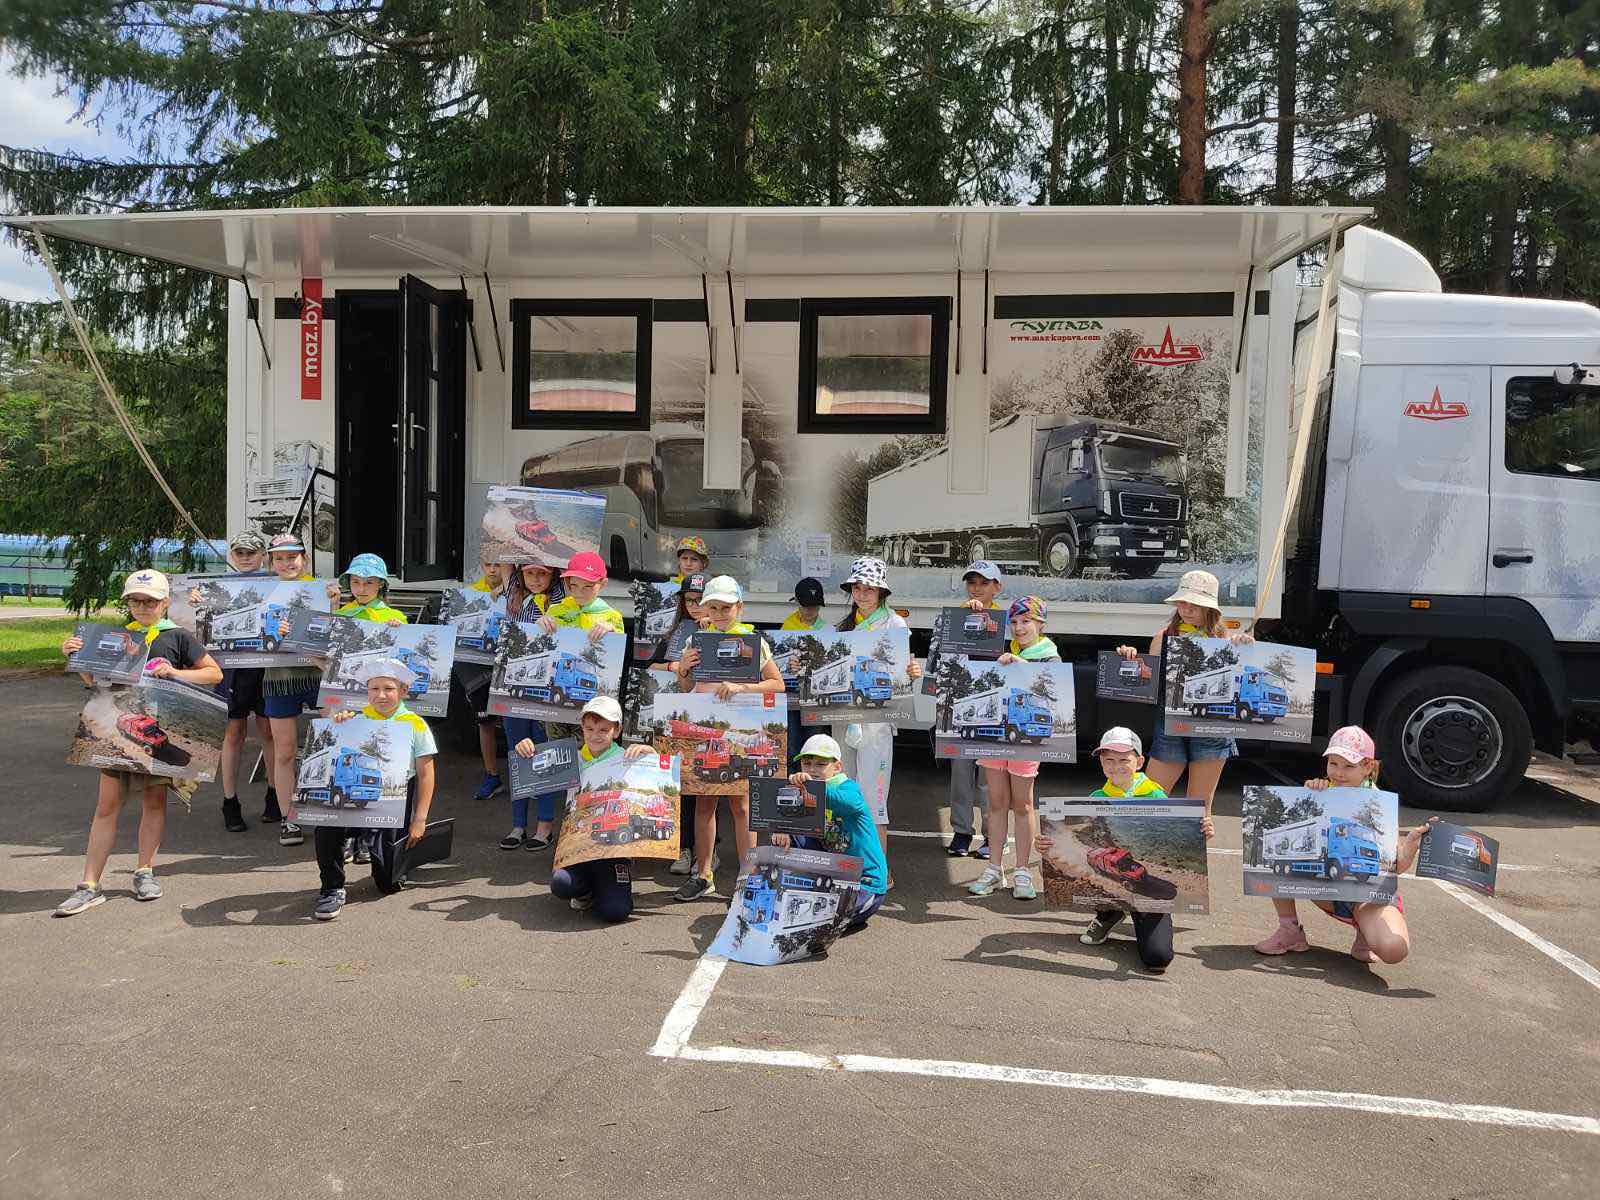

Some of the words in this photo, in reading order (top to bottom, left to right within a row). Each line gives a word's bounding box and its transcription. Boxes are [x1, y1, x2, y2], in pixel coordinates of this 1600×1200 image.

[303, 297, 322, 378] maz.by
[1041, 750, 1071, 761] maz.by
[752, 781, 761, 818] EURO-5
[365, 815, 399, 825] maz.by
